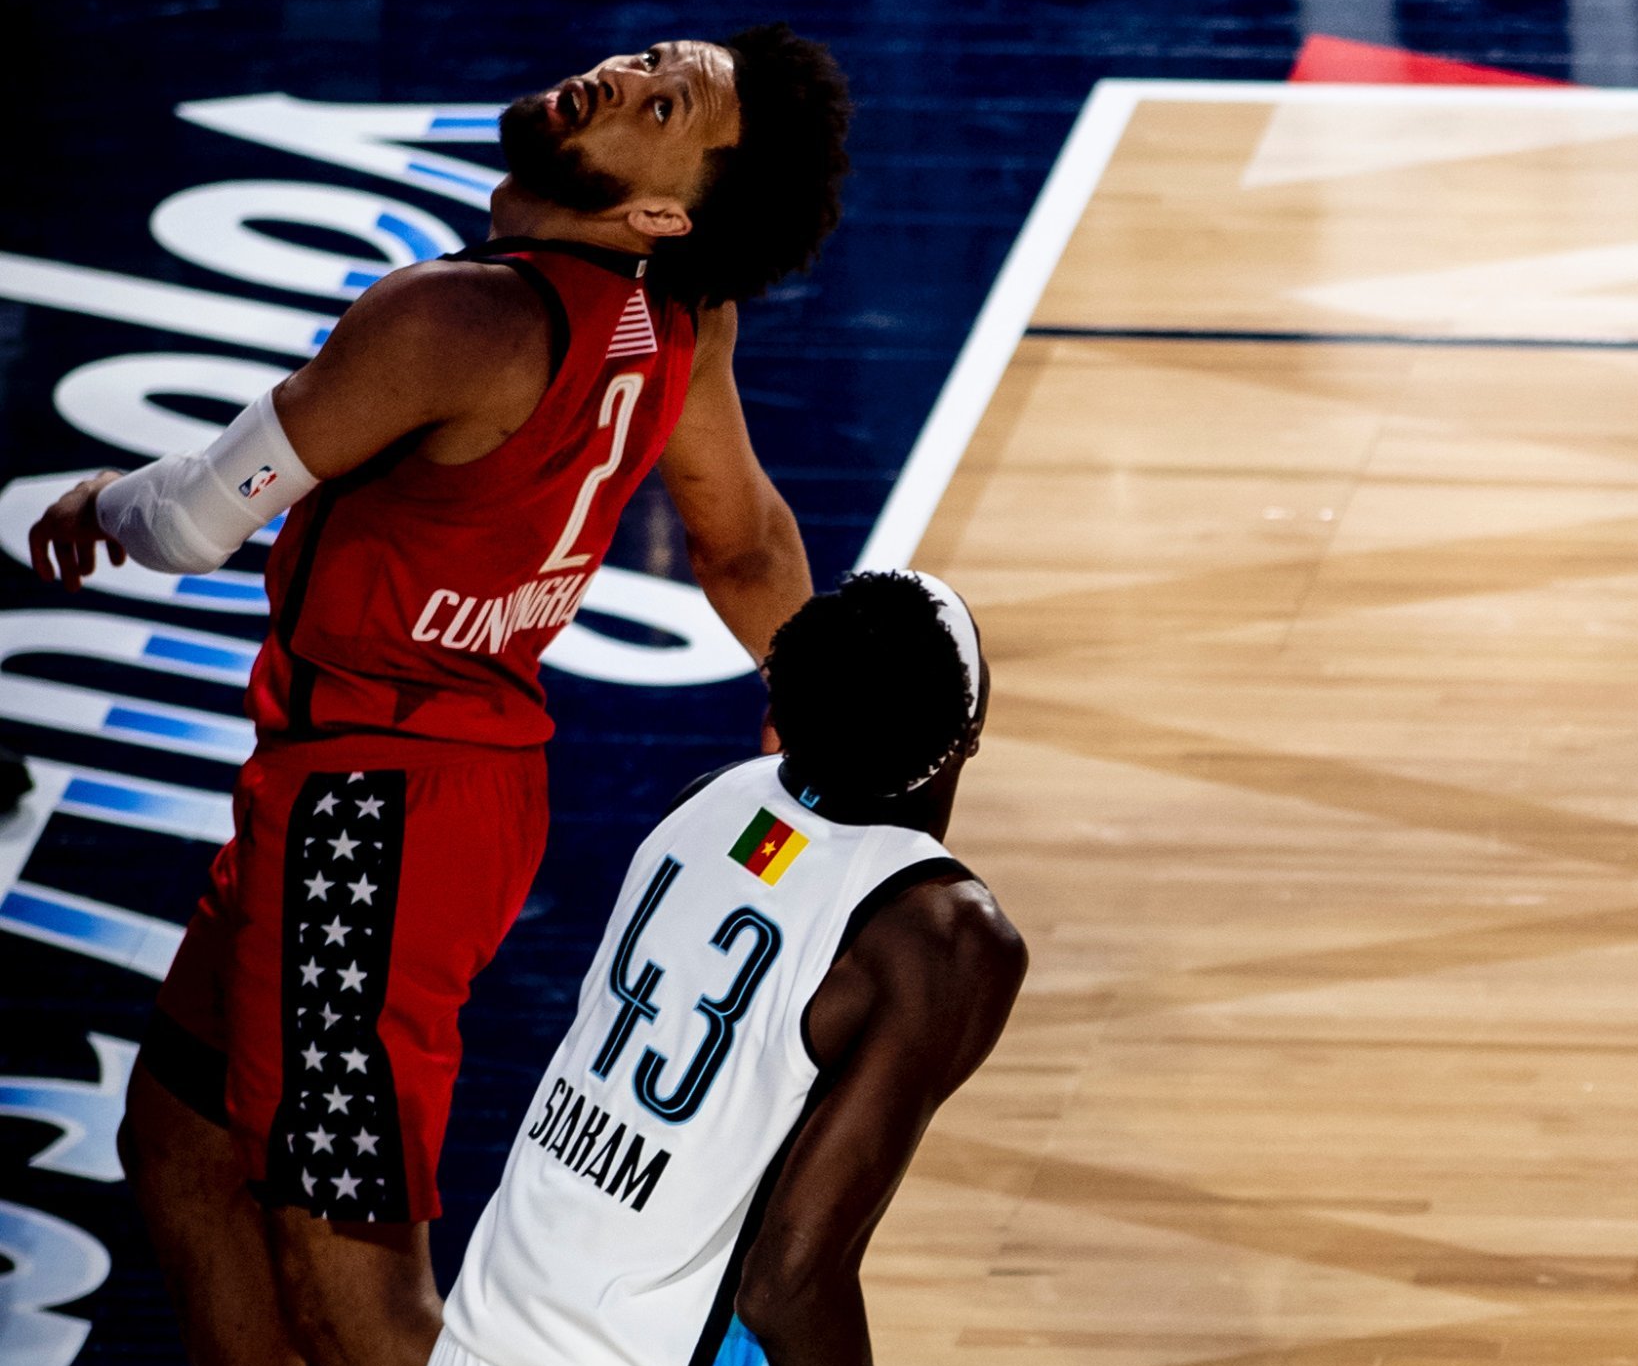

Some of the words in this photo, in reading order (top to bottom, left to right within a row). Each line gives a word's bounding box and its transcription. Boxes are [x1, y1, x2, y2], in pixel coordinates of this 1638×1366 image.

[538, 372, 645, 574] 2
[590, 853, 785, 1126] 43
[527, 1076, 672, 1213] SIAKAM
